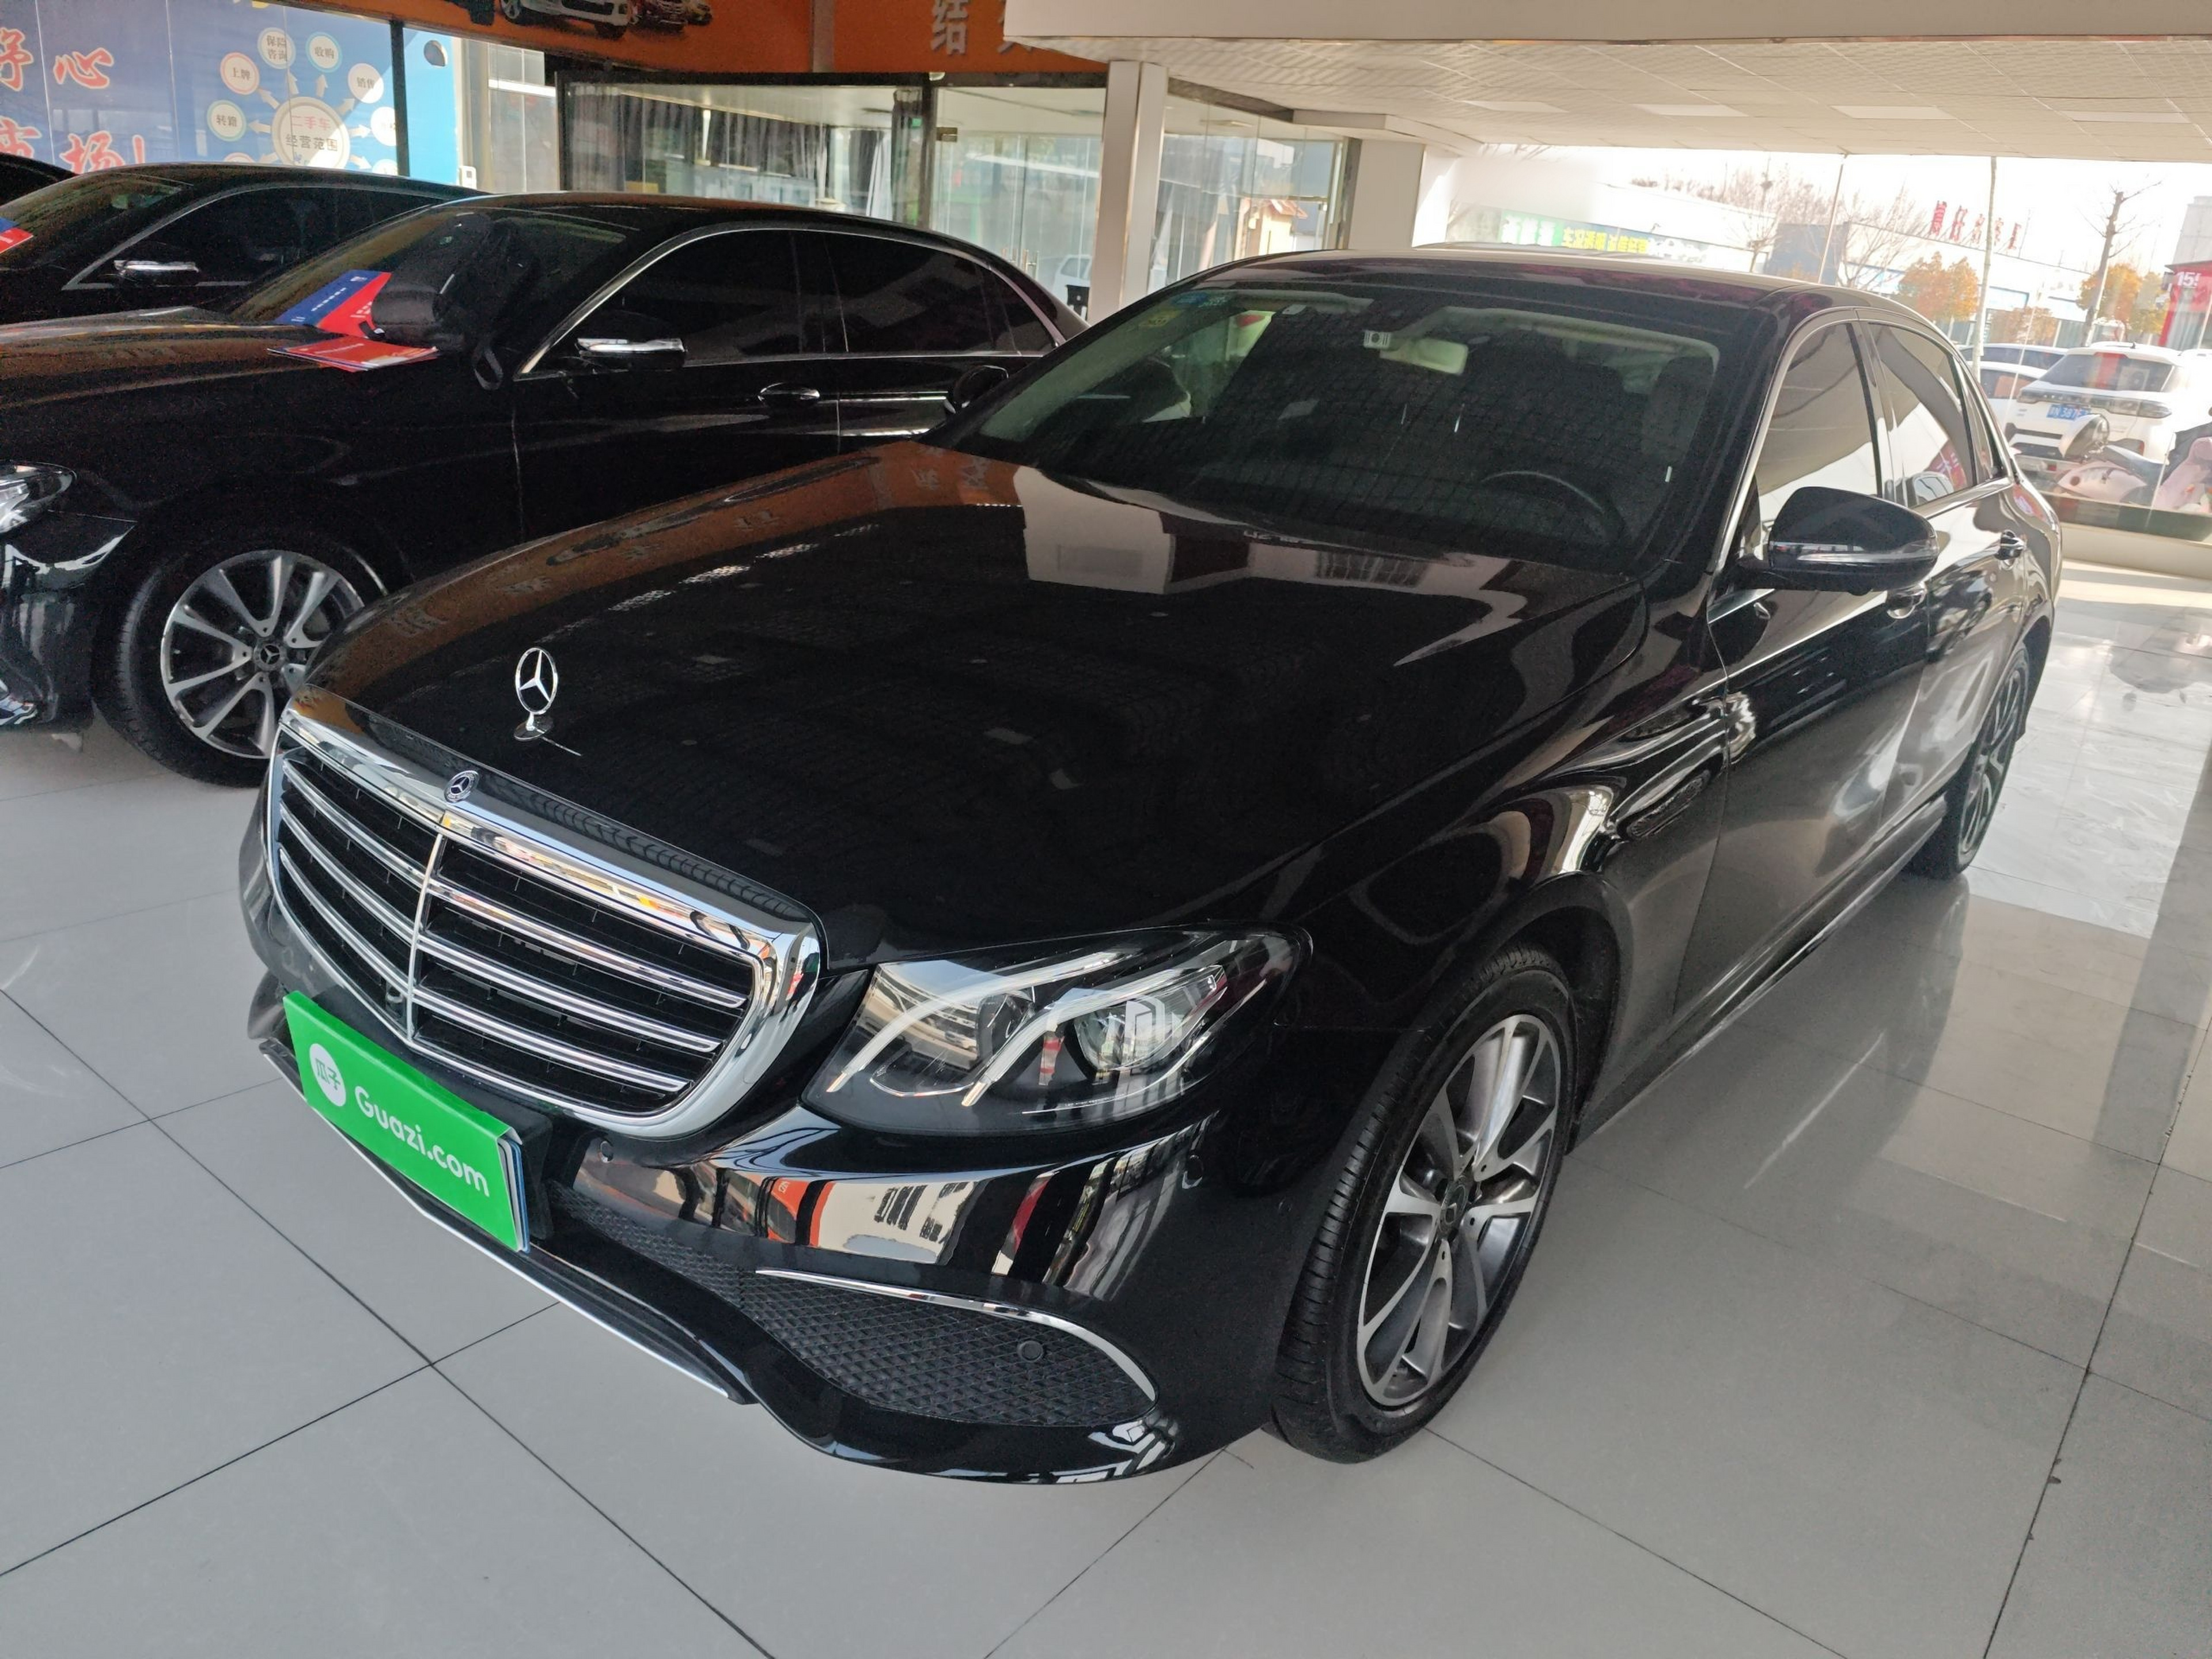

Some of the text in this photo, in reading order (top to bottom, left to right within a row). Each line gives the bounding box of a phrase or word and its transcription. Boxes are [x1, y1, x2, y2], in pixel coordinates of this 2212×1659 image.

[232, 67, 251, 81] 上牌
[291, 115, 331, 131] 二手车
[285, 133, 339, 151] 经营范围
[315, 1056, 342, 1091] 瓜子
[354, 1085, 490, 1198] Guazi.com
